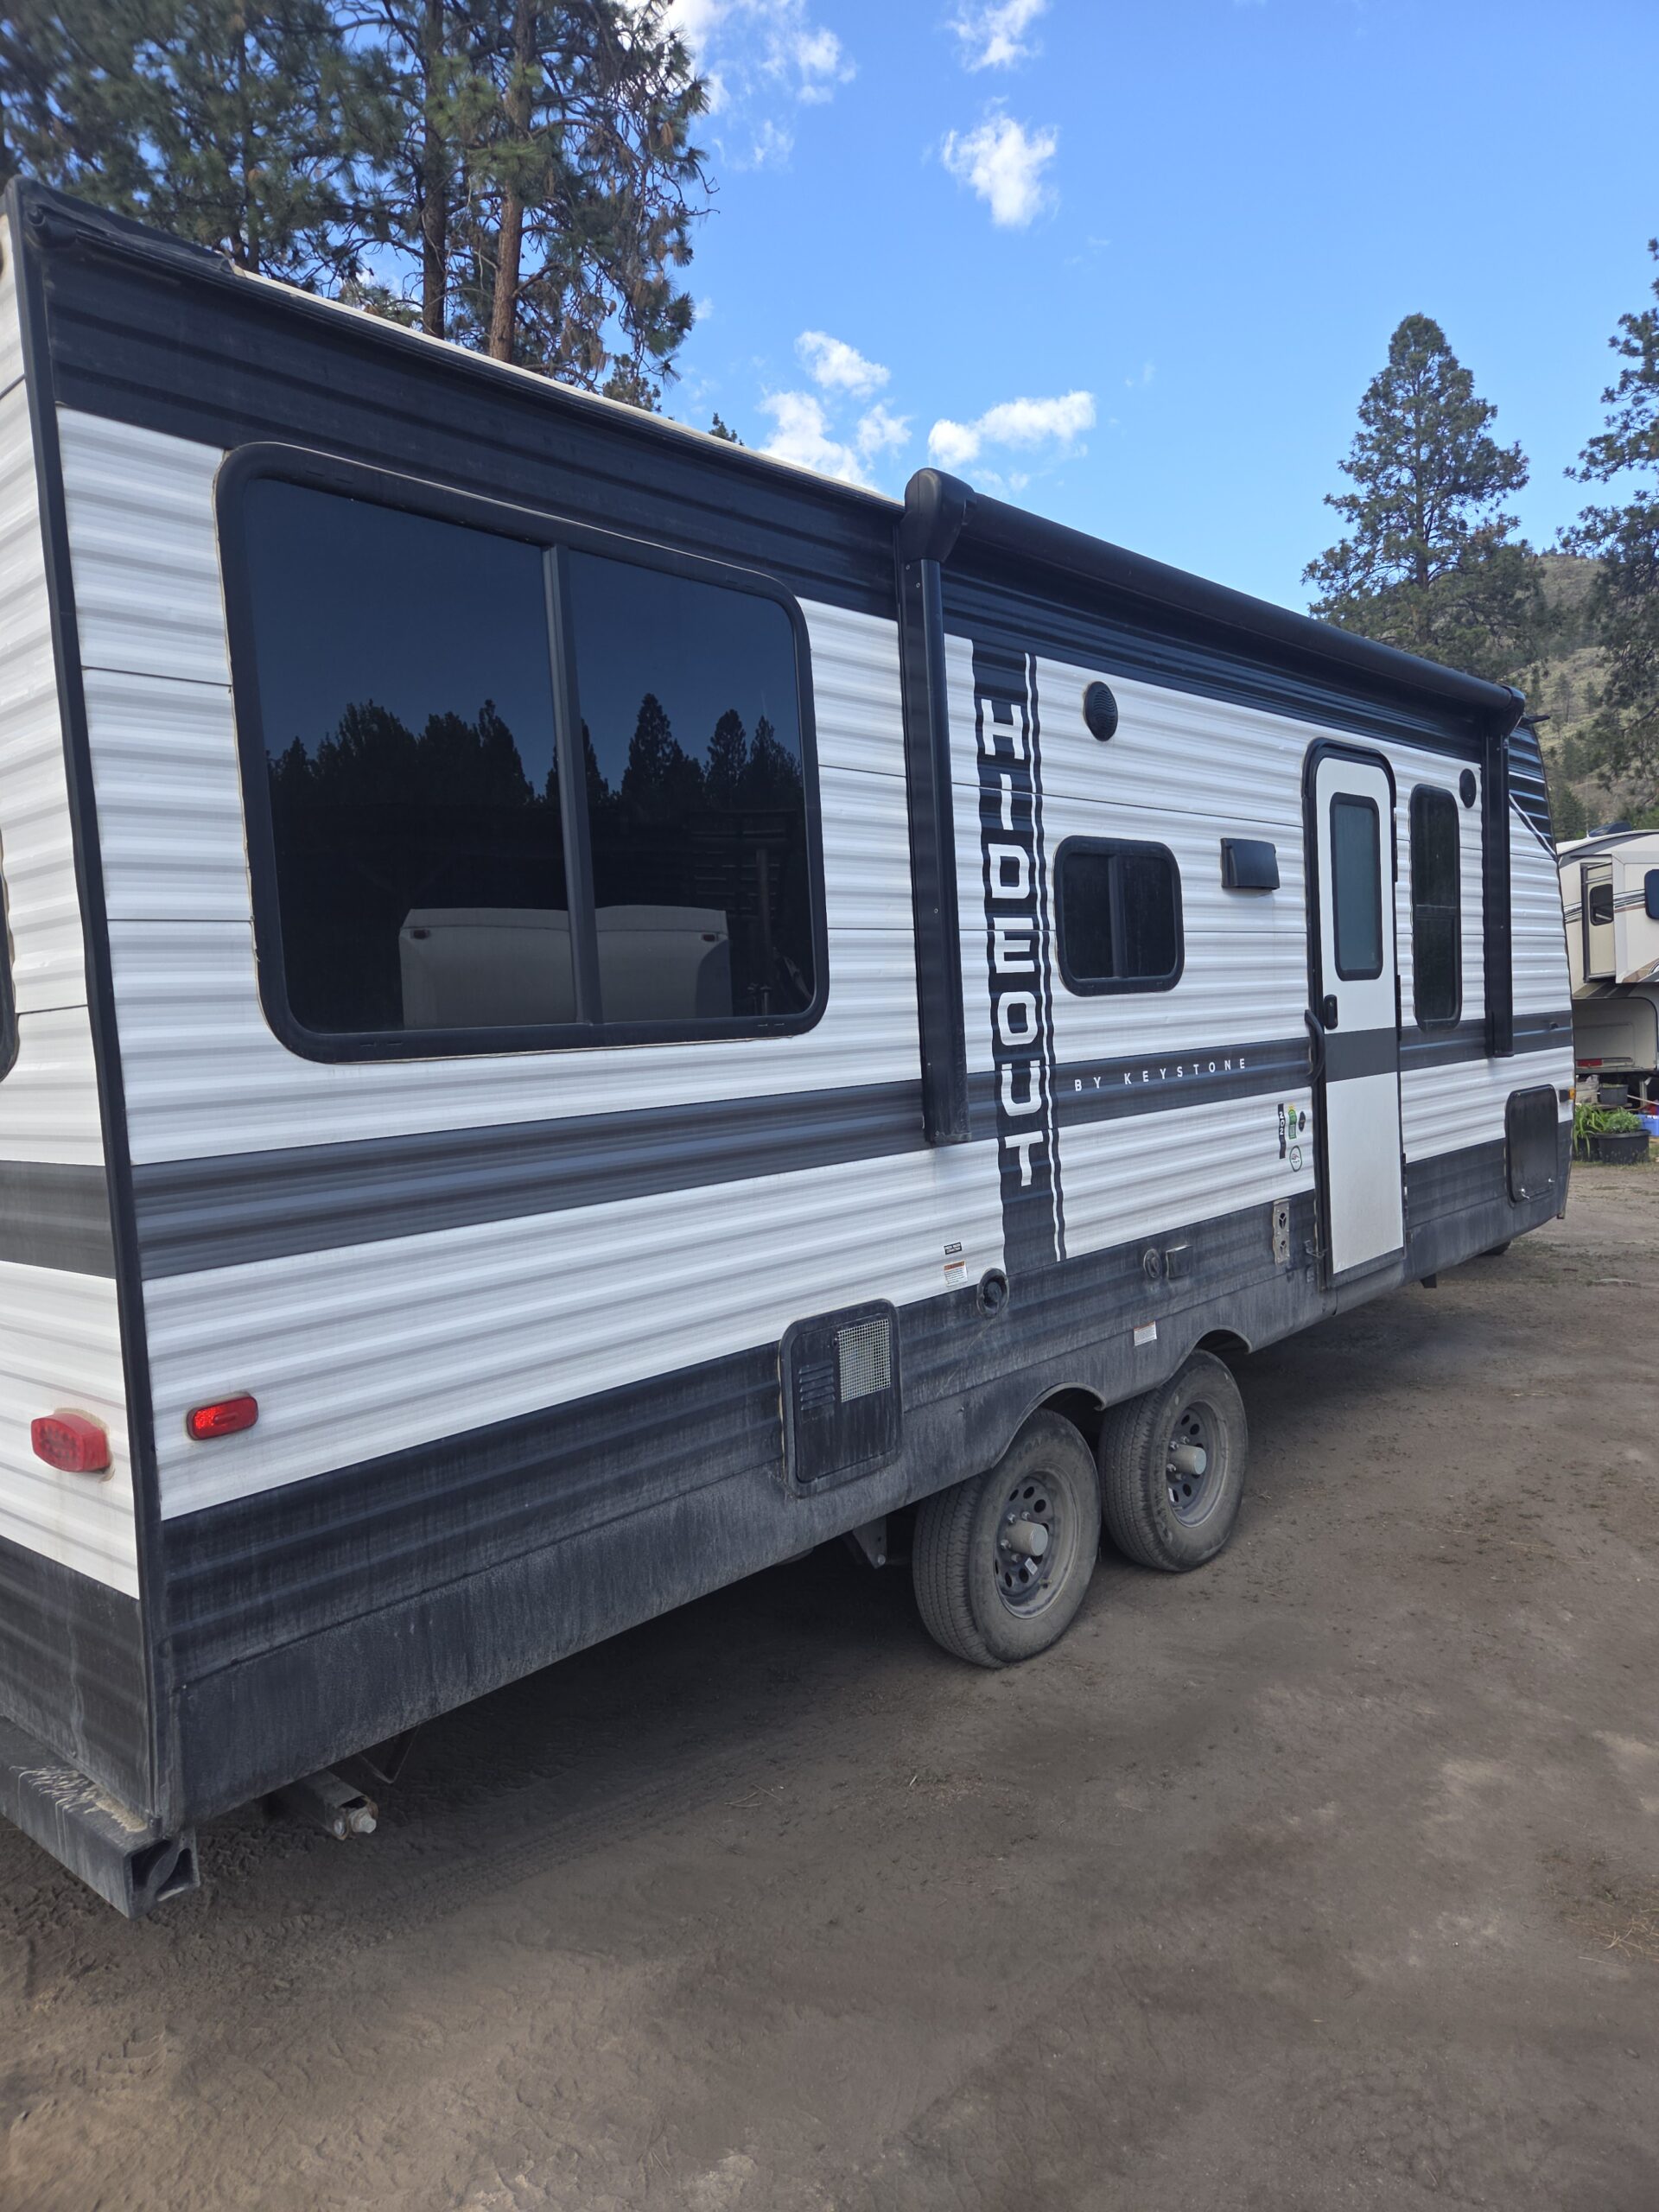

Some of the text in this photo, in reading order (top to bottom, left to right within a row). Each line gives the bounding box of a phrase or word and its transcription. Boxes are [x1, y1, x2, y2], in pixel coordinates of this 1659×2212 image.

[982, 699, 1044, 1186] HIDEOUT
[1074, 1058, 1245, 1092] BY KEYSTONE
